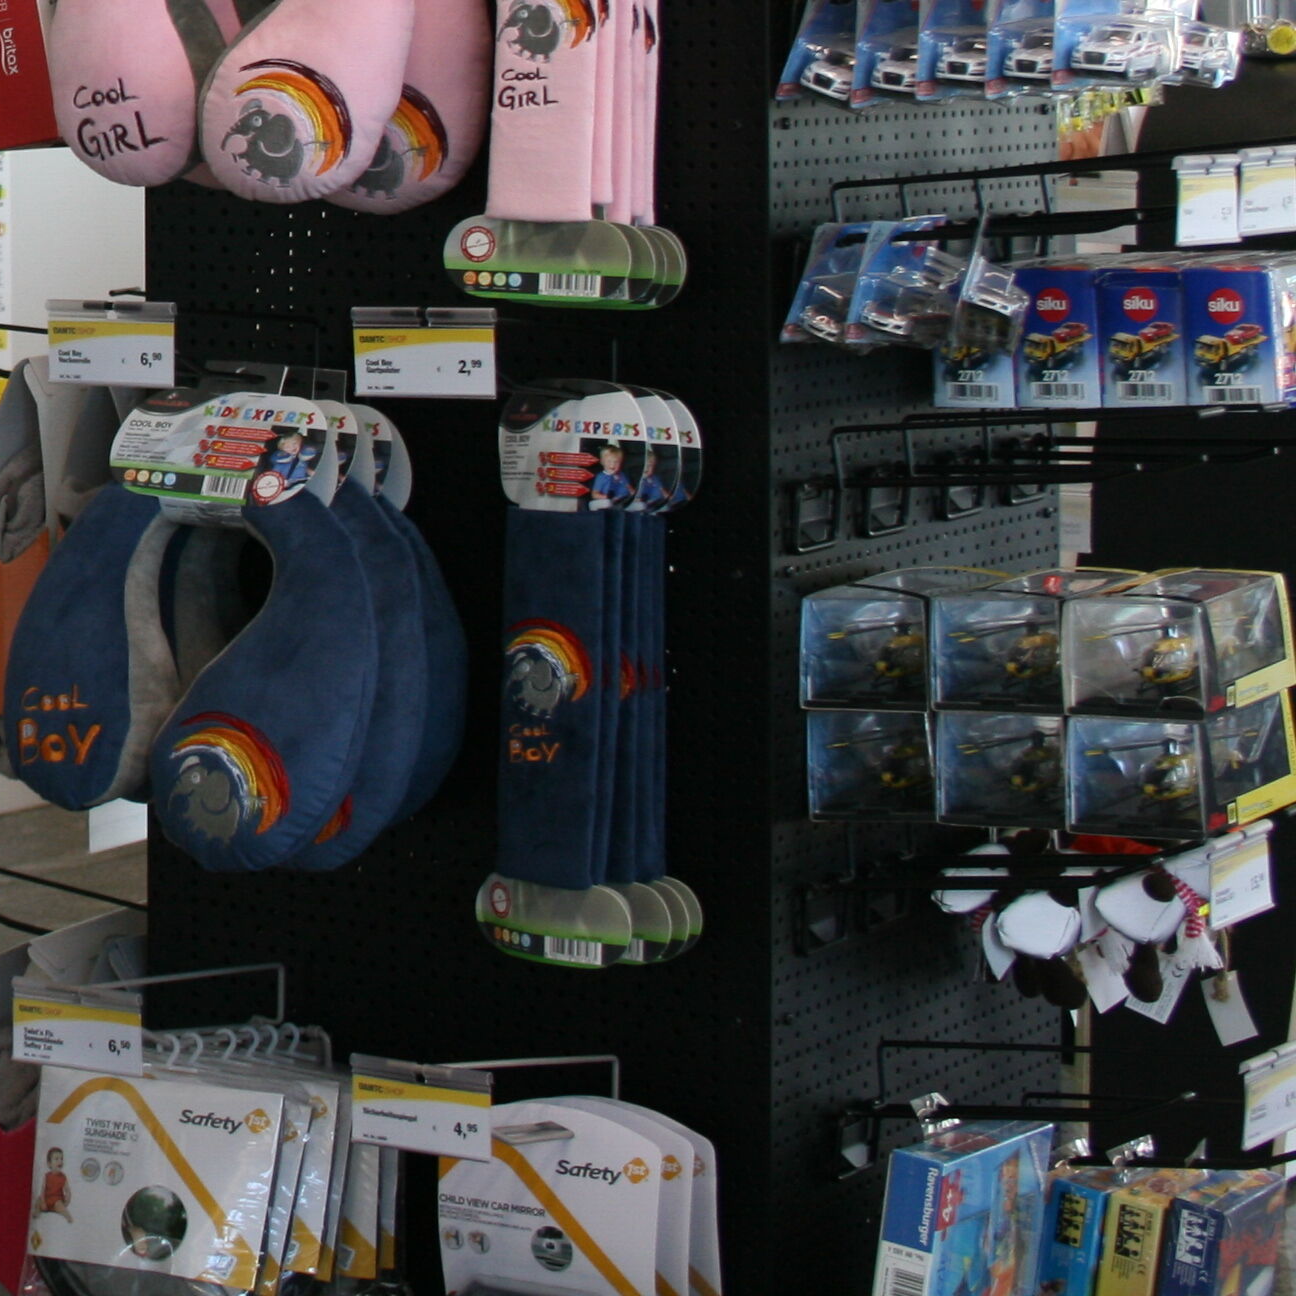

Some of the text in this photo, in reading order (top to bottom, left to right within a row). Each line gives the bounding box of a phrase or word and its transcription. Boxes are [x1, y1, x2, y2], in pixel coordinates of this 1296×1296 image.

[2, 27, 19, 75] britax
[1036, 297, 1068, 312] siku
[1123, 296, 1155, 311] siku
[1208, 297, 1241, 313] siku
[140, 352, 162, 368] 6,90
[458, 359, 482, 376] 2,99
[958, 370, 984, 381] 2712
[1042, 370, 1070, 382] 2712
[1128, 370, 1156, 382] 2712
[1214, 373, 1244, 385] 2712
[242, 408, 316, 425] EXPERTS
[574, 421, 640, 437] EXPERTS
[179, 1109, 266, 1135] Safety 1st
[454, 1122, 478, 1139] 4,95
[555, 1159, 646, 1185] Safety 1st
[439, 1193, 546, 1218] CHILD VIEW CAR MIRROR
[918, 1167, 939, 1247] Ravensburger
